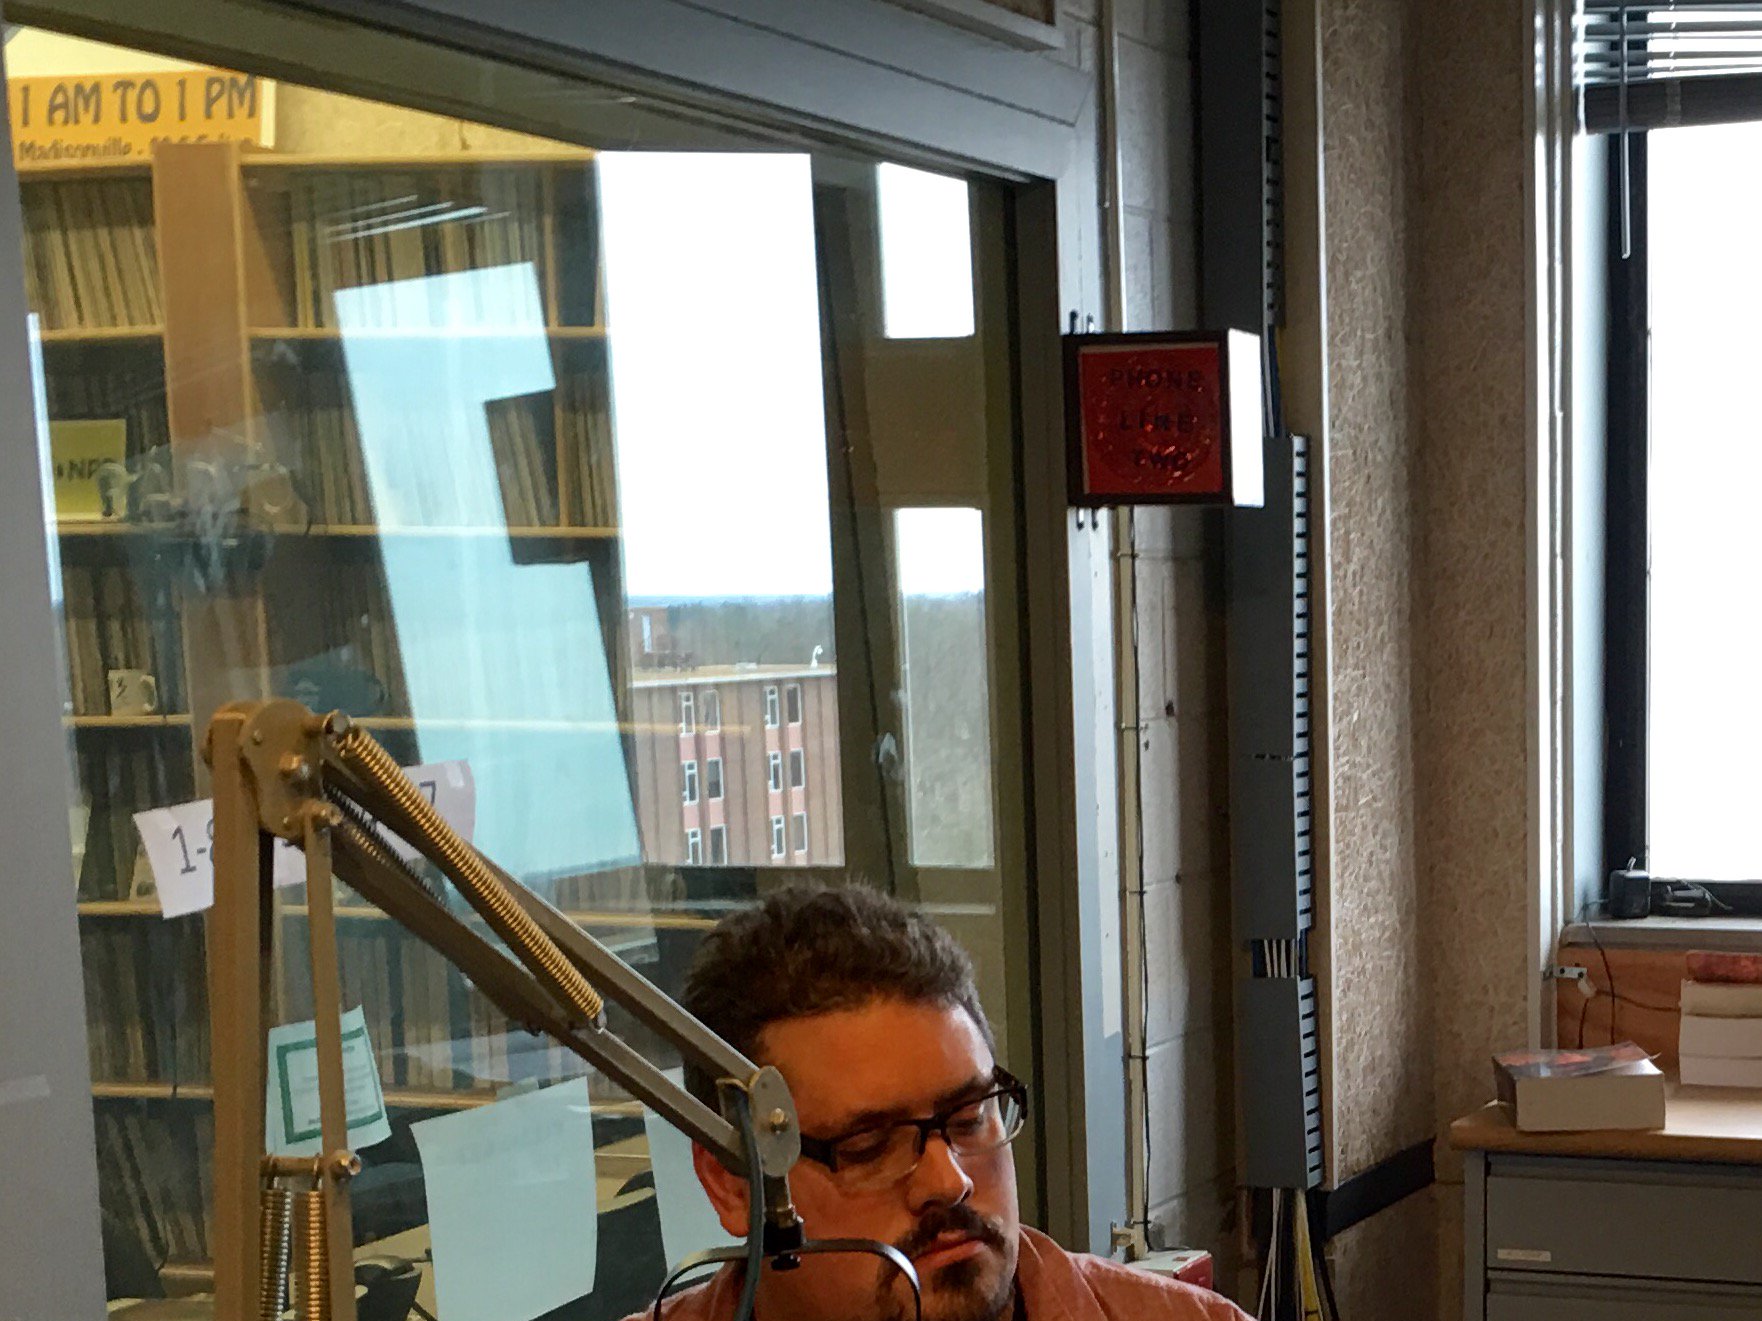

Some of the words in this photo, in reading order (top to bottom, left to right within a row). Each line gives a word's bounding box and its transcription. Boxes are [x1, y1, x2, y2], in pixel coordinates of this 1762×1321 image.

[47, 80, 102, 127] AM
[112, 78, 162, 124] TO
[177, 77, 187, 122] 1
[204, 75, 256, 120] PM
